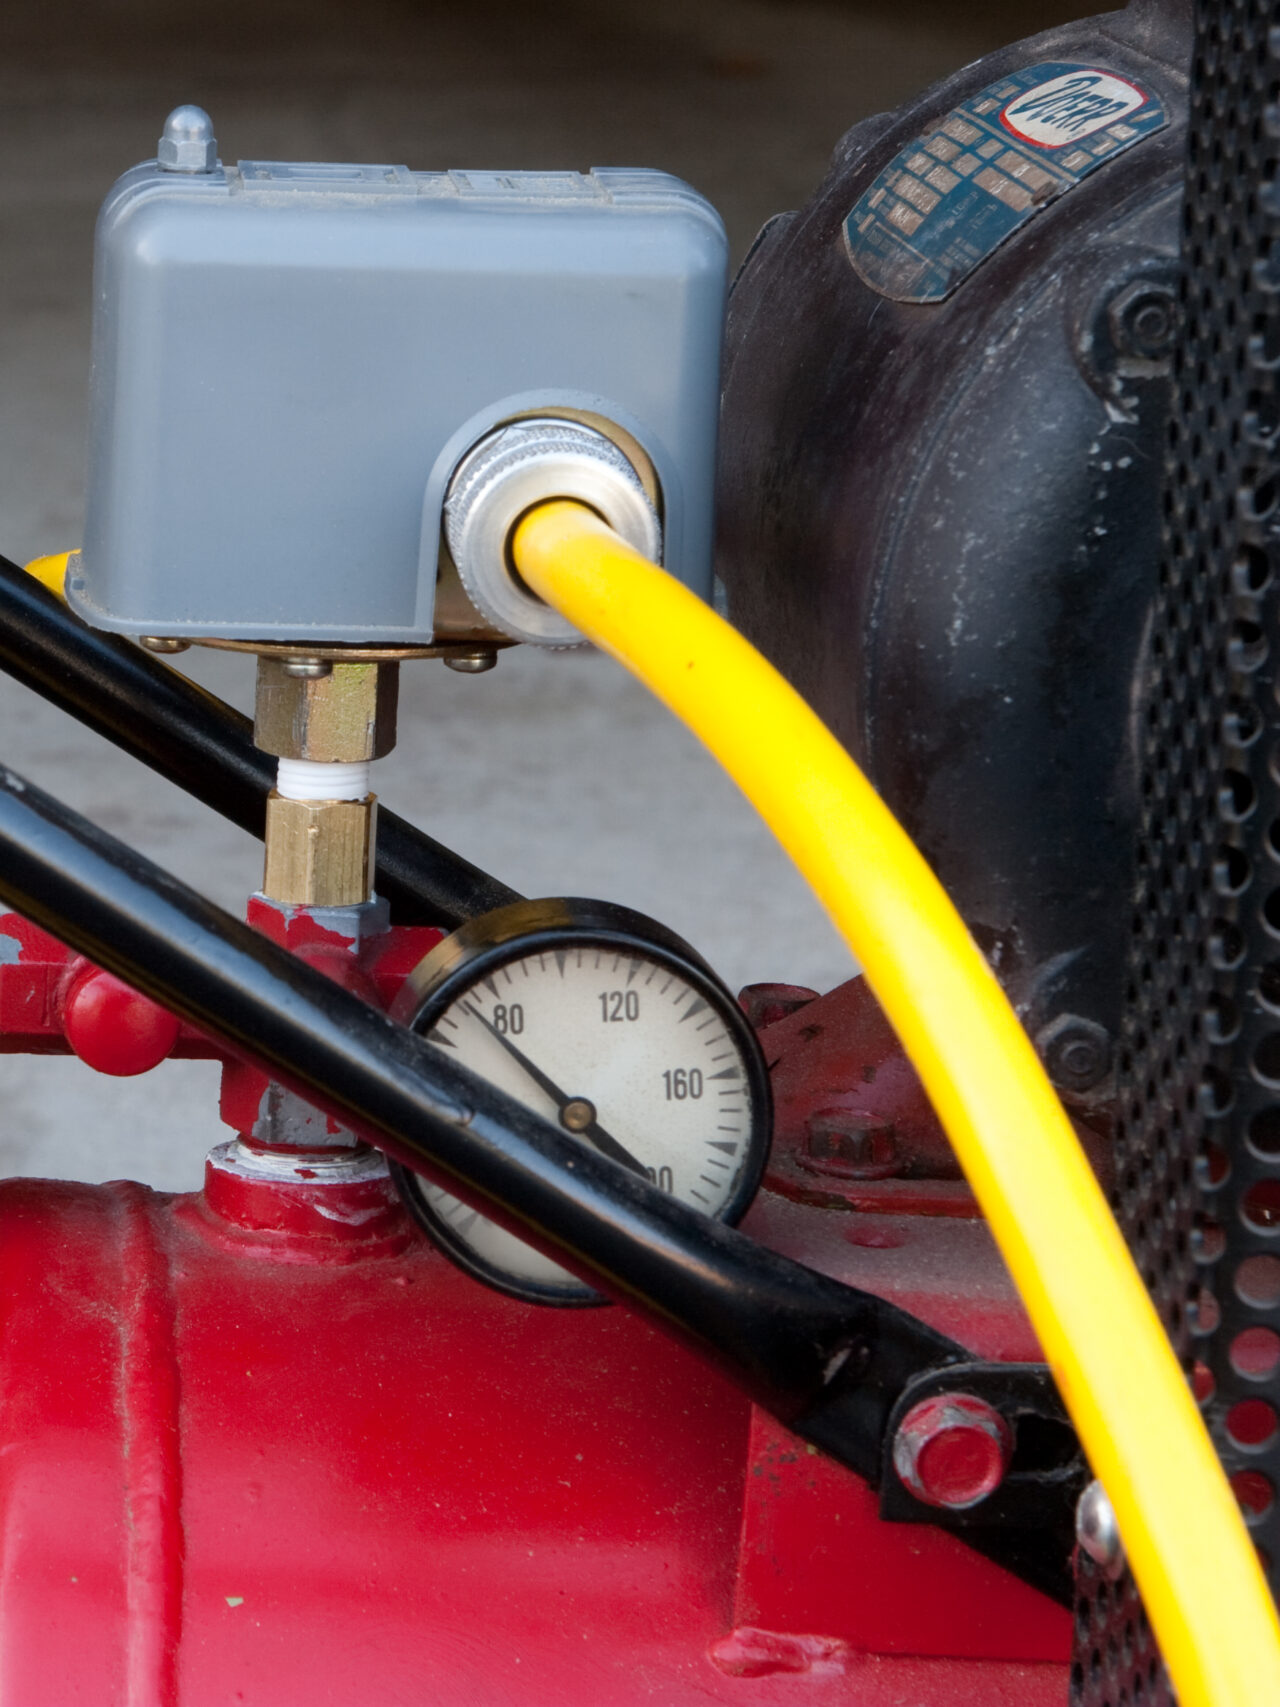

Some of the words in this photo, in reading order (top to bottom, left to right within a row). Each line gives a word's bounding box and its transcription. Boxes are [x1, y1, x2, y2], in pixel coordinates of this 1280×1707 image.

[493, 1003, 524, 1035] 80
[598, 990, 640, 1023] 120
[662, 1068, 703, 1101] 160
